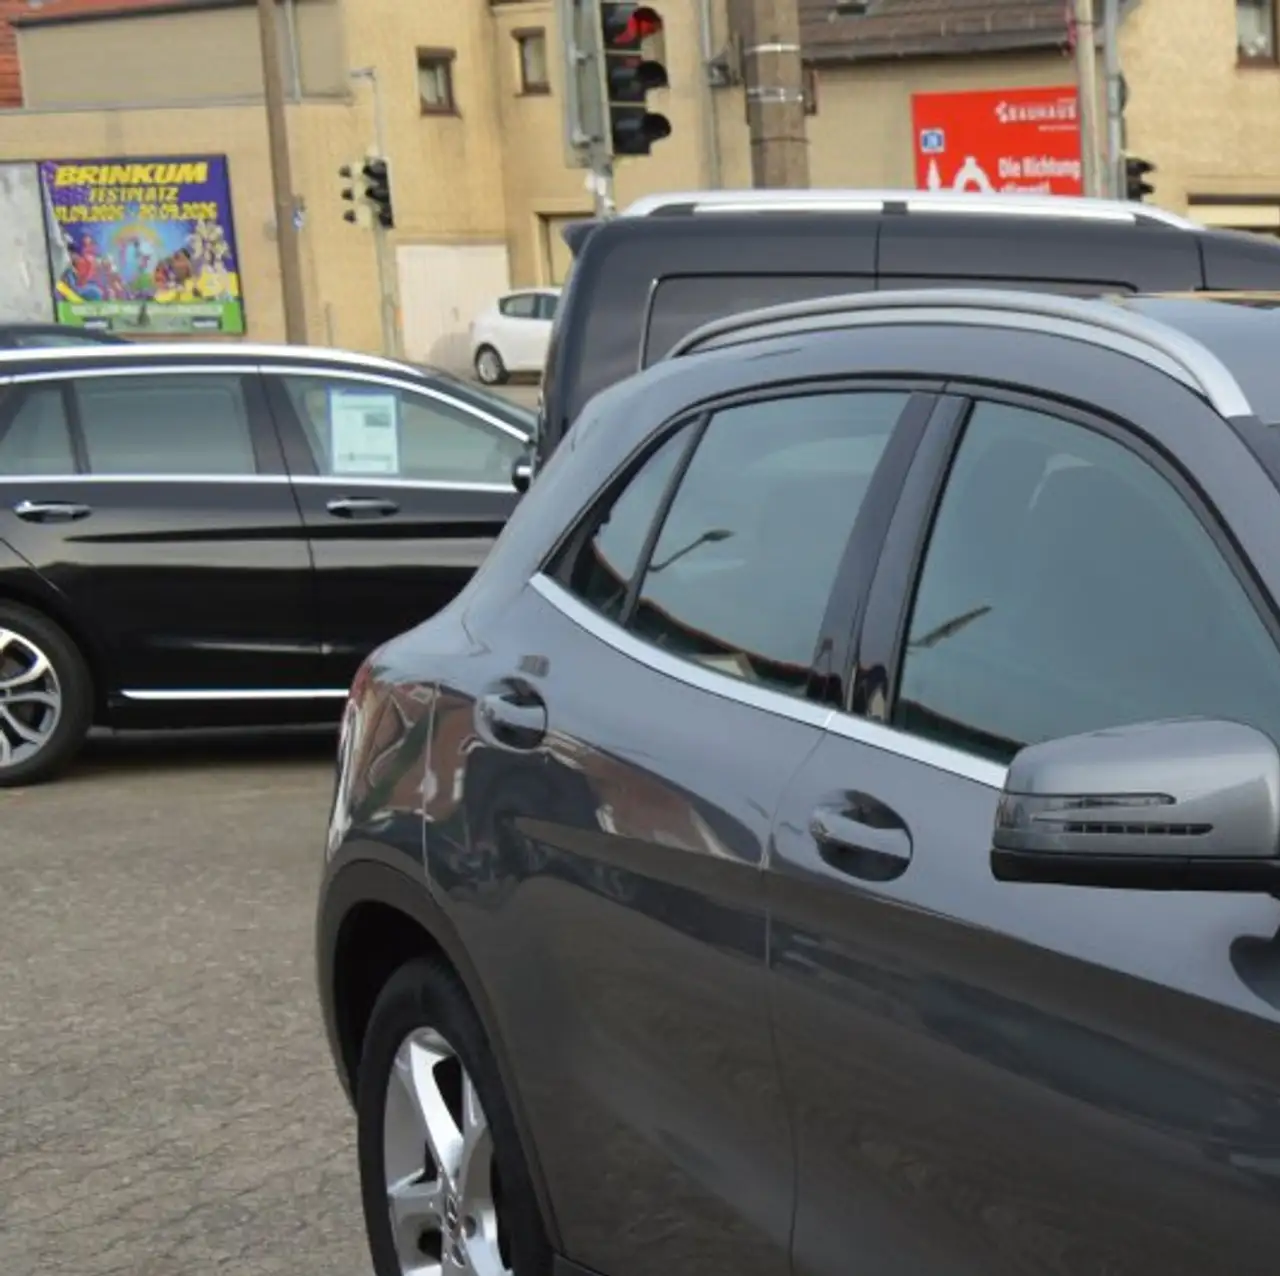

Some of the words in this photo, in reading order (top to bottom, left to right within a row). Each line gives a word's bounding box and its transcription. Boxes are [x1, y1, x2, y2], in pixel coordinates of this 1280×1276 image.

[55, 162, 208, 187] BRINKUM
[998, 157, 1021, 179] Die
[1022, 155, 1081, 182] Richtung
